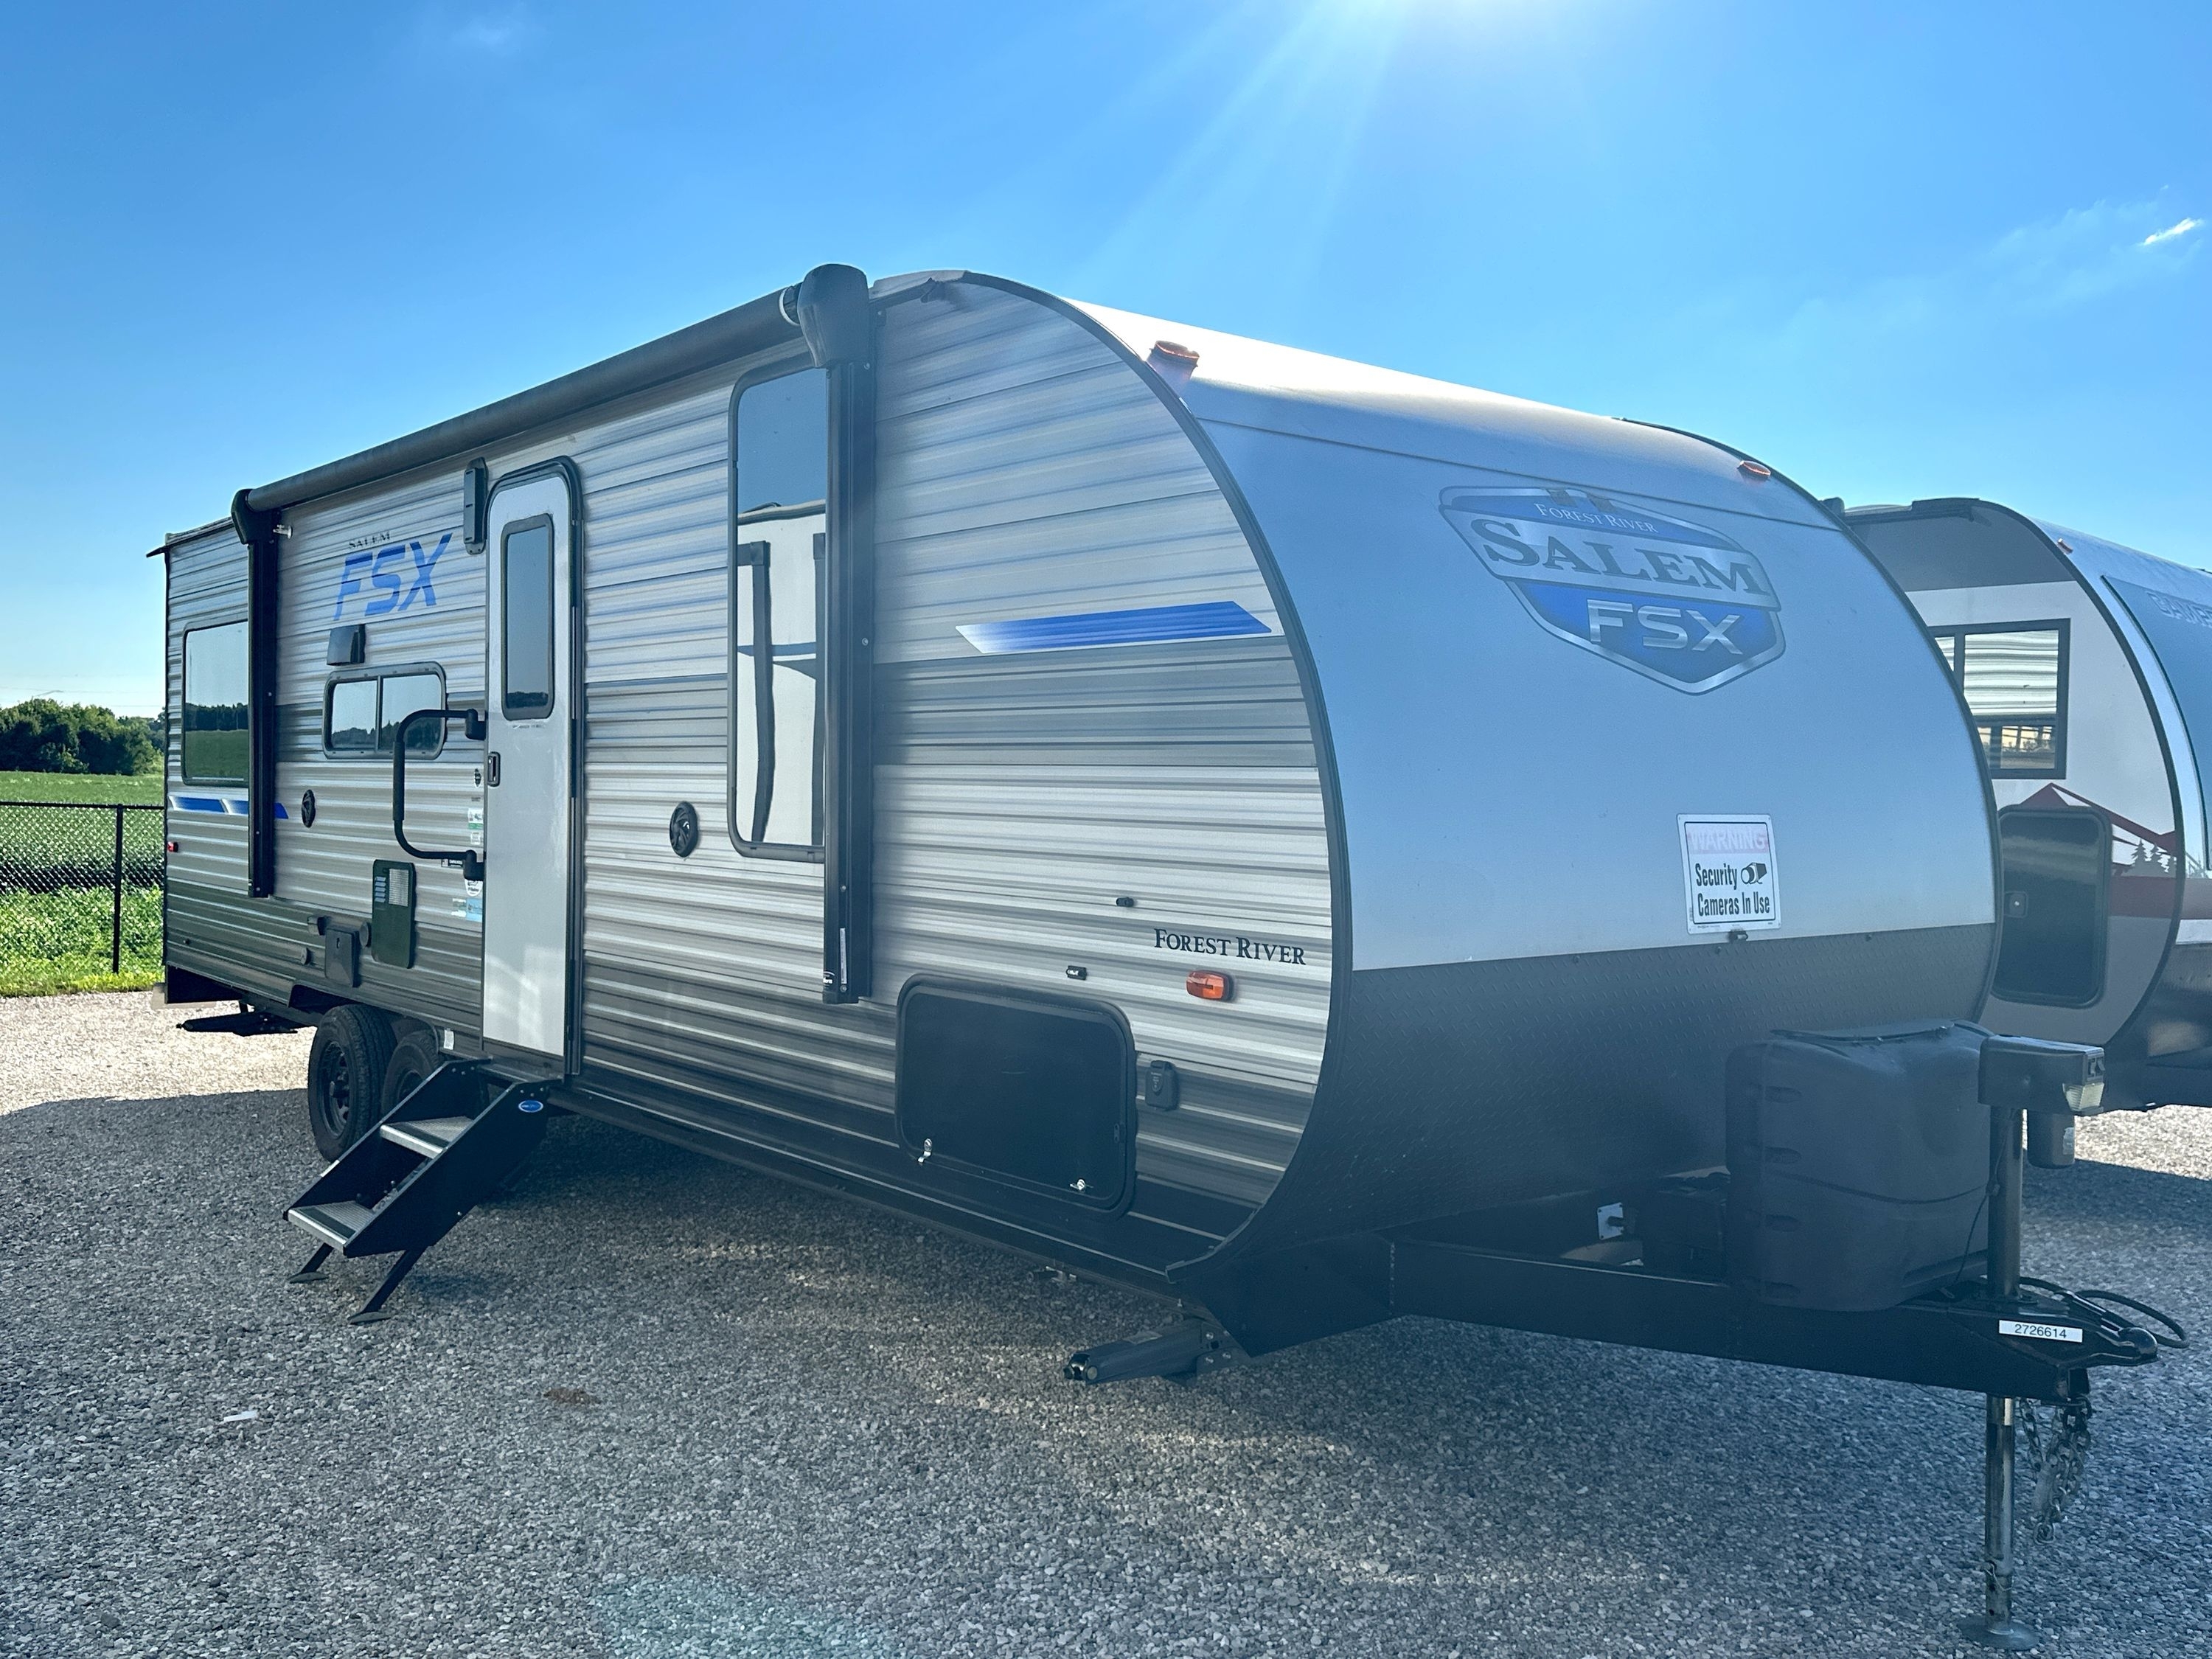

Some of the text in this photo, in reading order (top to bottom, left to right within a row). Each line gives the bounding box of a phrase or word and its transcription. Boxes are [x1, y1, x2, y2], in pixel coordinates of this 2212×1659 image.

[1534, 503, 1658, 534] FOREST RIVER
[349, 531, 391, 549] SALEM
[1470, 518, 1769, 595] SALEM
[333, 532, 453, 621] FSX
[1586, 599, 1743, 655] FSX
[1690, 830, 1766, 851] WARNING
[1695, 863, 1738, 890] Security
[1697, 892, 1739, 917] Cameras
[1742, 891, 1751, 914] In
[1753, 891, 1770, 914] Use
[1153, 928, 1307, 965] FOREST RIVER
[2014, 1324, 2067, 1338] 2726614
